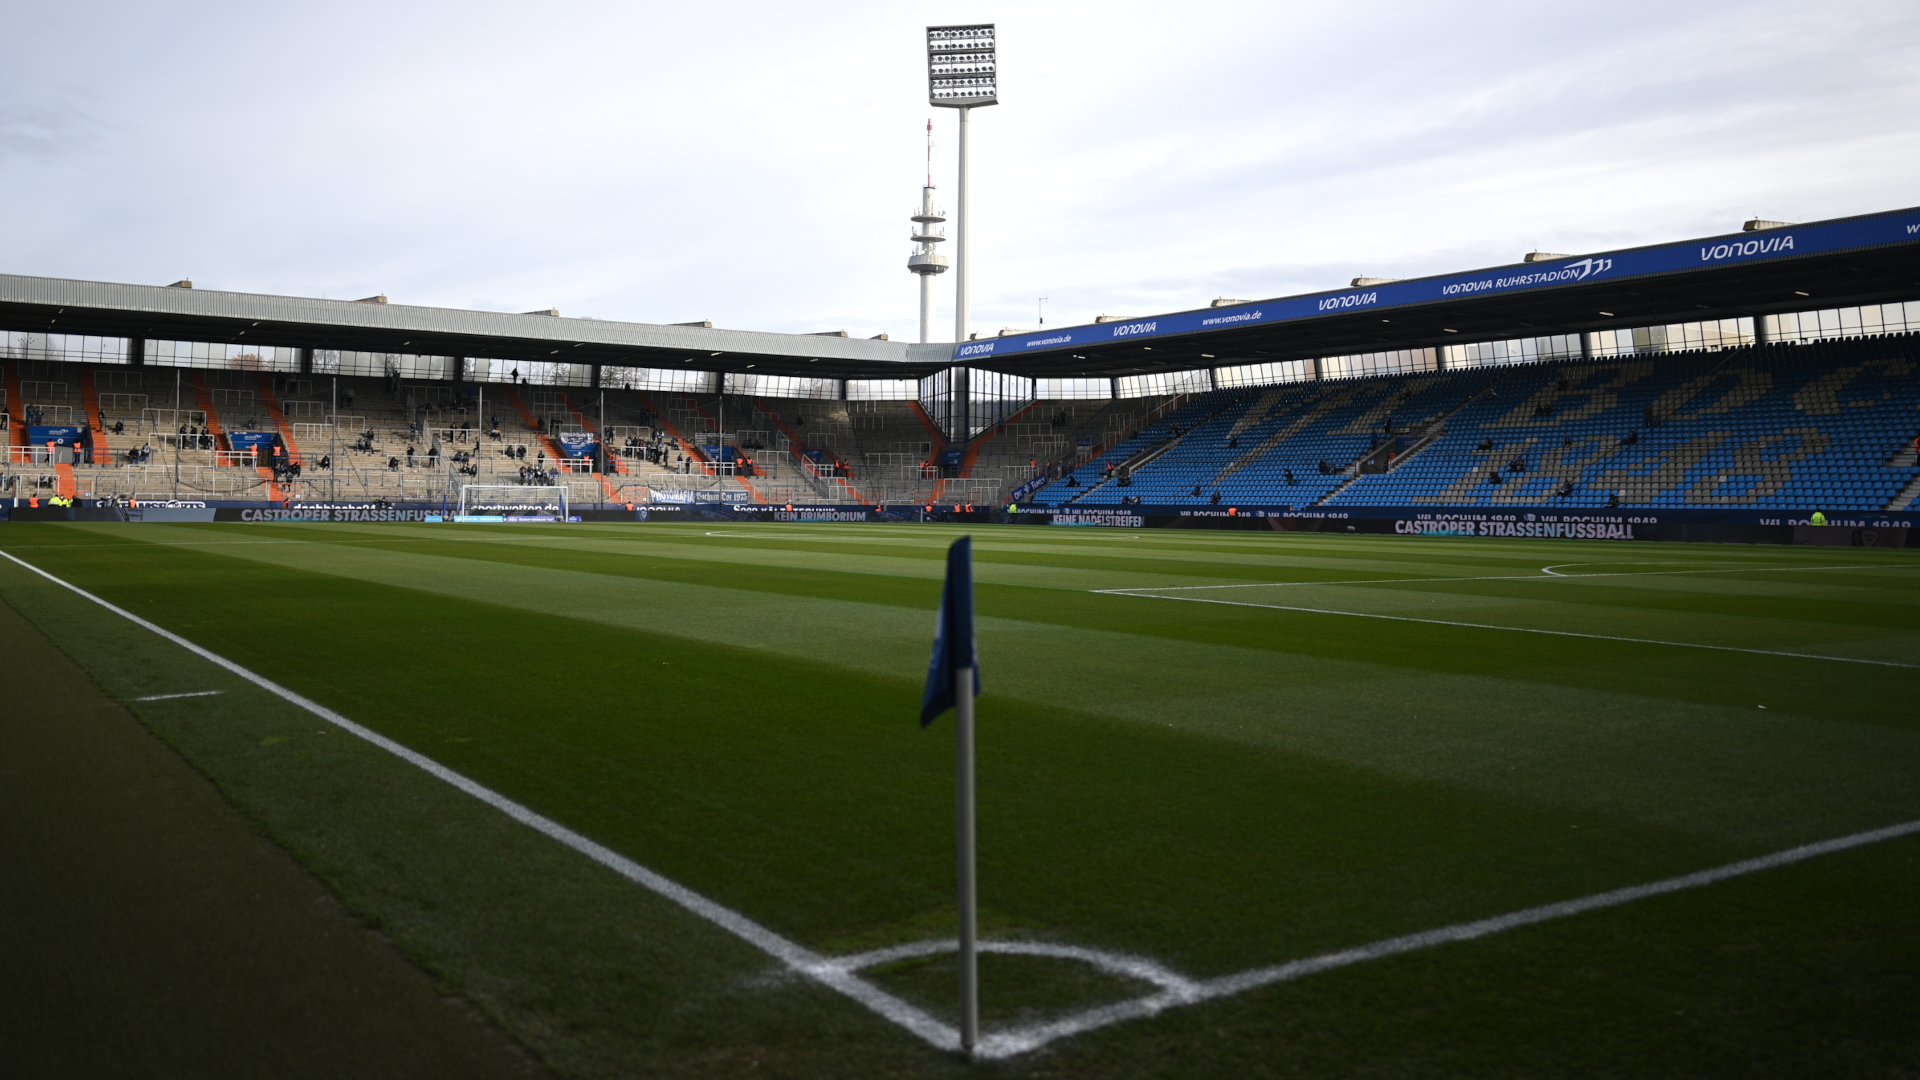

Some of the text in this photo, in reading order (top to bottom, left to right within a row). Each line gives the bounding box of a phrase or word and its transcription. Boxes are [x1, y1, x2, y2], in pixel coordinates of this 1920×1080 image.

[1701, 235, 1794, 261] VONOVIA
[1443, 268, 1581, 295] VONOVIA RUHRSTADION
[1318, 292, 1377, 311] VONOVIA
[1202, 310, 1262, 326] www.vonovia.de
[1113, 322, 1157, 337] VONOVIA
[1026, 334, 1072, 348] www.vonovia.de
[960, 342, 995, 356] VONOVIA
[241, 509, 330, 522] CASTROPER
[774, 511, 866, 522] KEIN BRIMBORIUM
[1053, 514, 1145, 528] KEINE NADELSTREIFEN
[1395, 520, 1634, 540] CASTROPER STRASSENFUSSBALL
